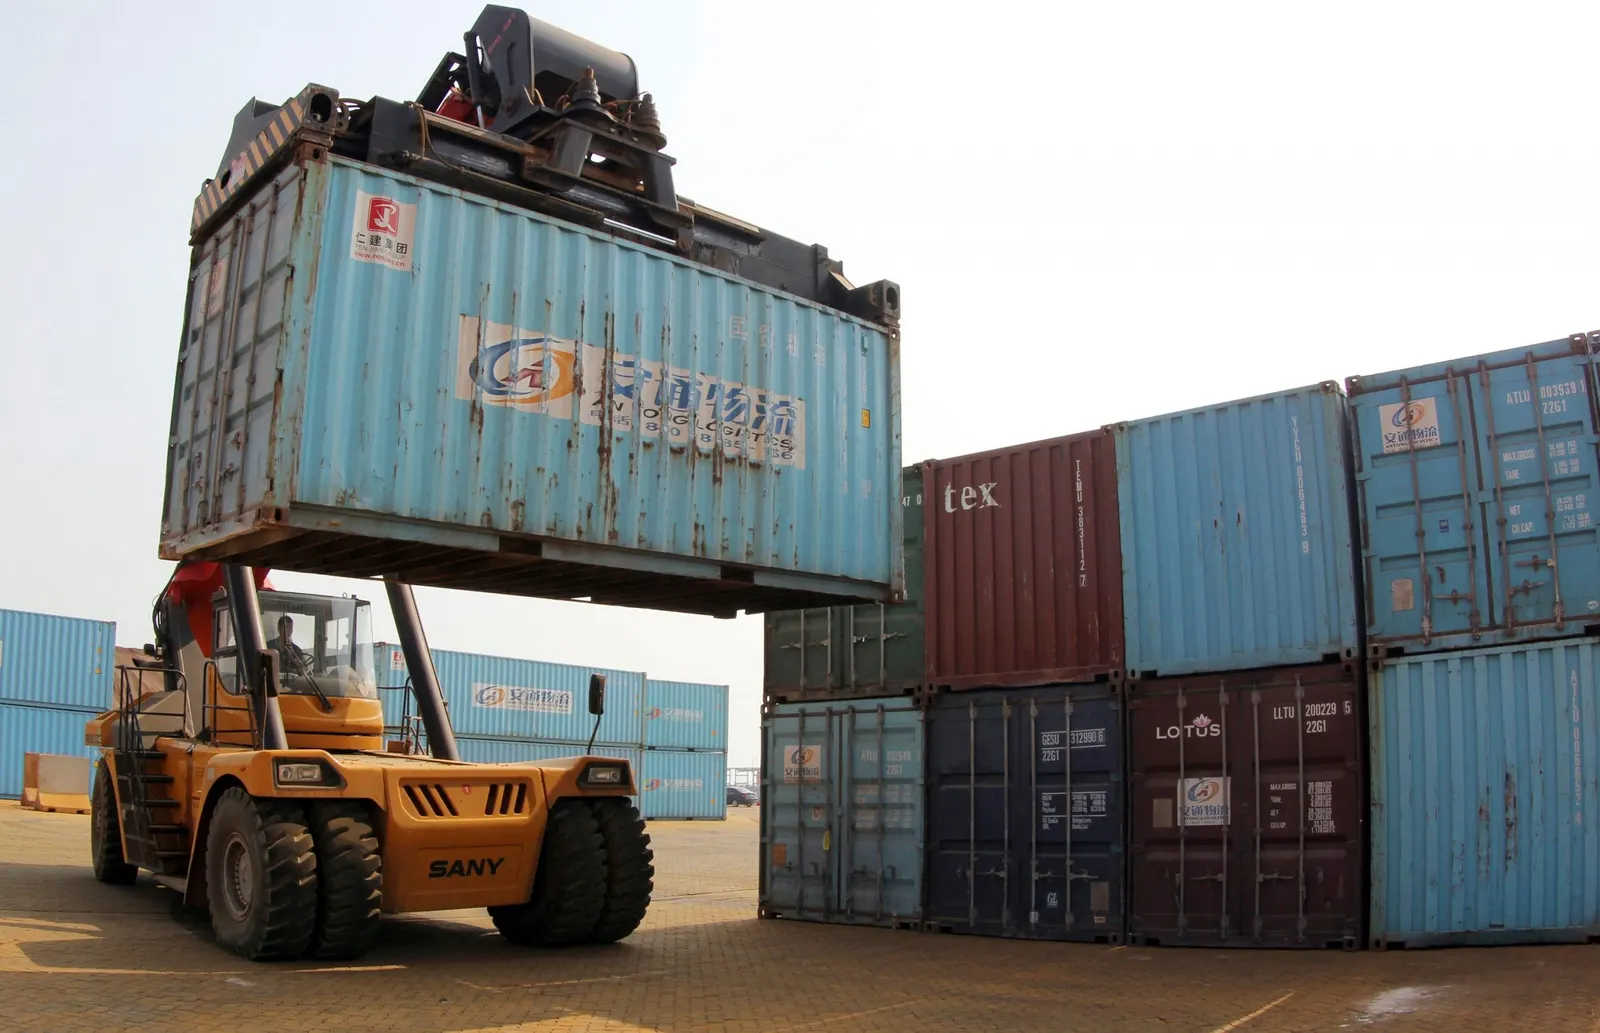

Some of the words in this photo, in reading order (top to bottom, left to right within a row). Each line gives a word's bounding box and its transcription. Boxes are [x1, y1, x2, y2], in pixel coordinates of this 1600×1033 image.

[356, 232, 408, 254] 仁建集团
[1506, 389, 1531, 405] ATLU
[1542, 399, 1567, 414] 22G1
[1075, 460, 1084, 502] TEMU
[944, 481, 1000, 513] tex
[1077, 506, 1086, 571] 383112
[1080, 575, 1087, 586] 7
[1273, 706, 1295, 720] LLTU
[1305, 702, 1337, 717] 200229
[1344, 701, 1351, 715] 5
[1156, 723, 1221, 739] LOTUS
[1306, 720, 1327, 733] 22G1
[1042, 734, 1060, 746] GESU
[1070, 731, 1097, 744] 312990
[1042, 750, 1060, 761] 22G1
[428, 857, 506, 878] SANY
